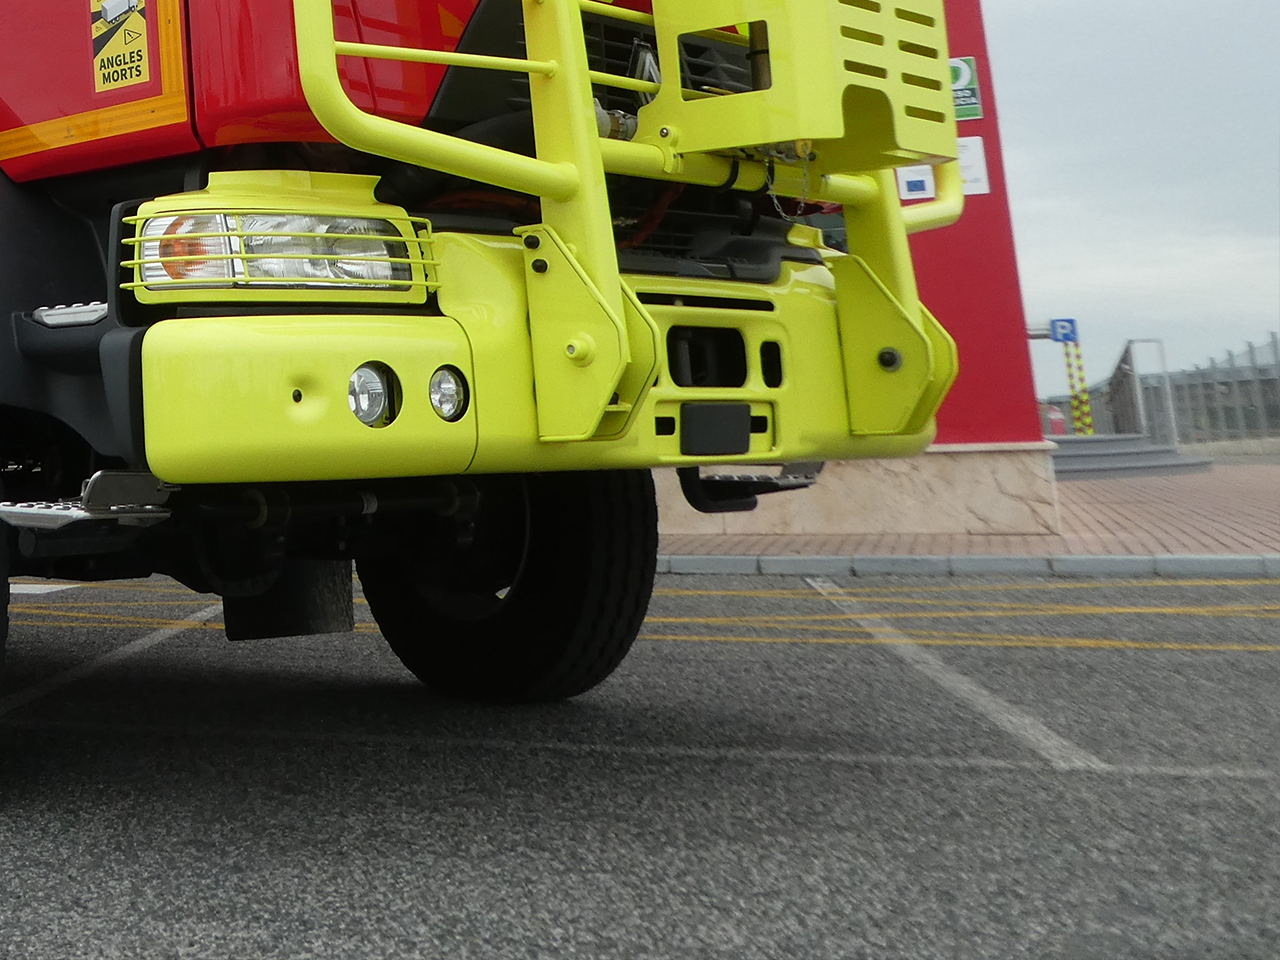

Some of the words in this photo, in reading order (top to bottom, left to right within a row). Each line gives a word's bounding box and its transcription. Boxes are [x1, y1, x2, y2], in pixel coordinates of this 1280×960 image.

[99, 49, 143, 71] ANGLES
[102, 65, 142, 85] MORTS
[1056, 321, 1072, 339] P
